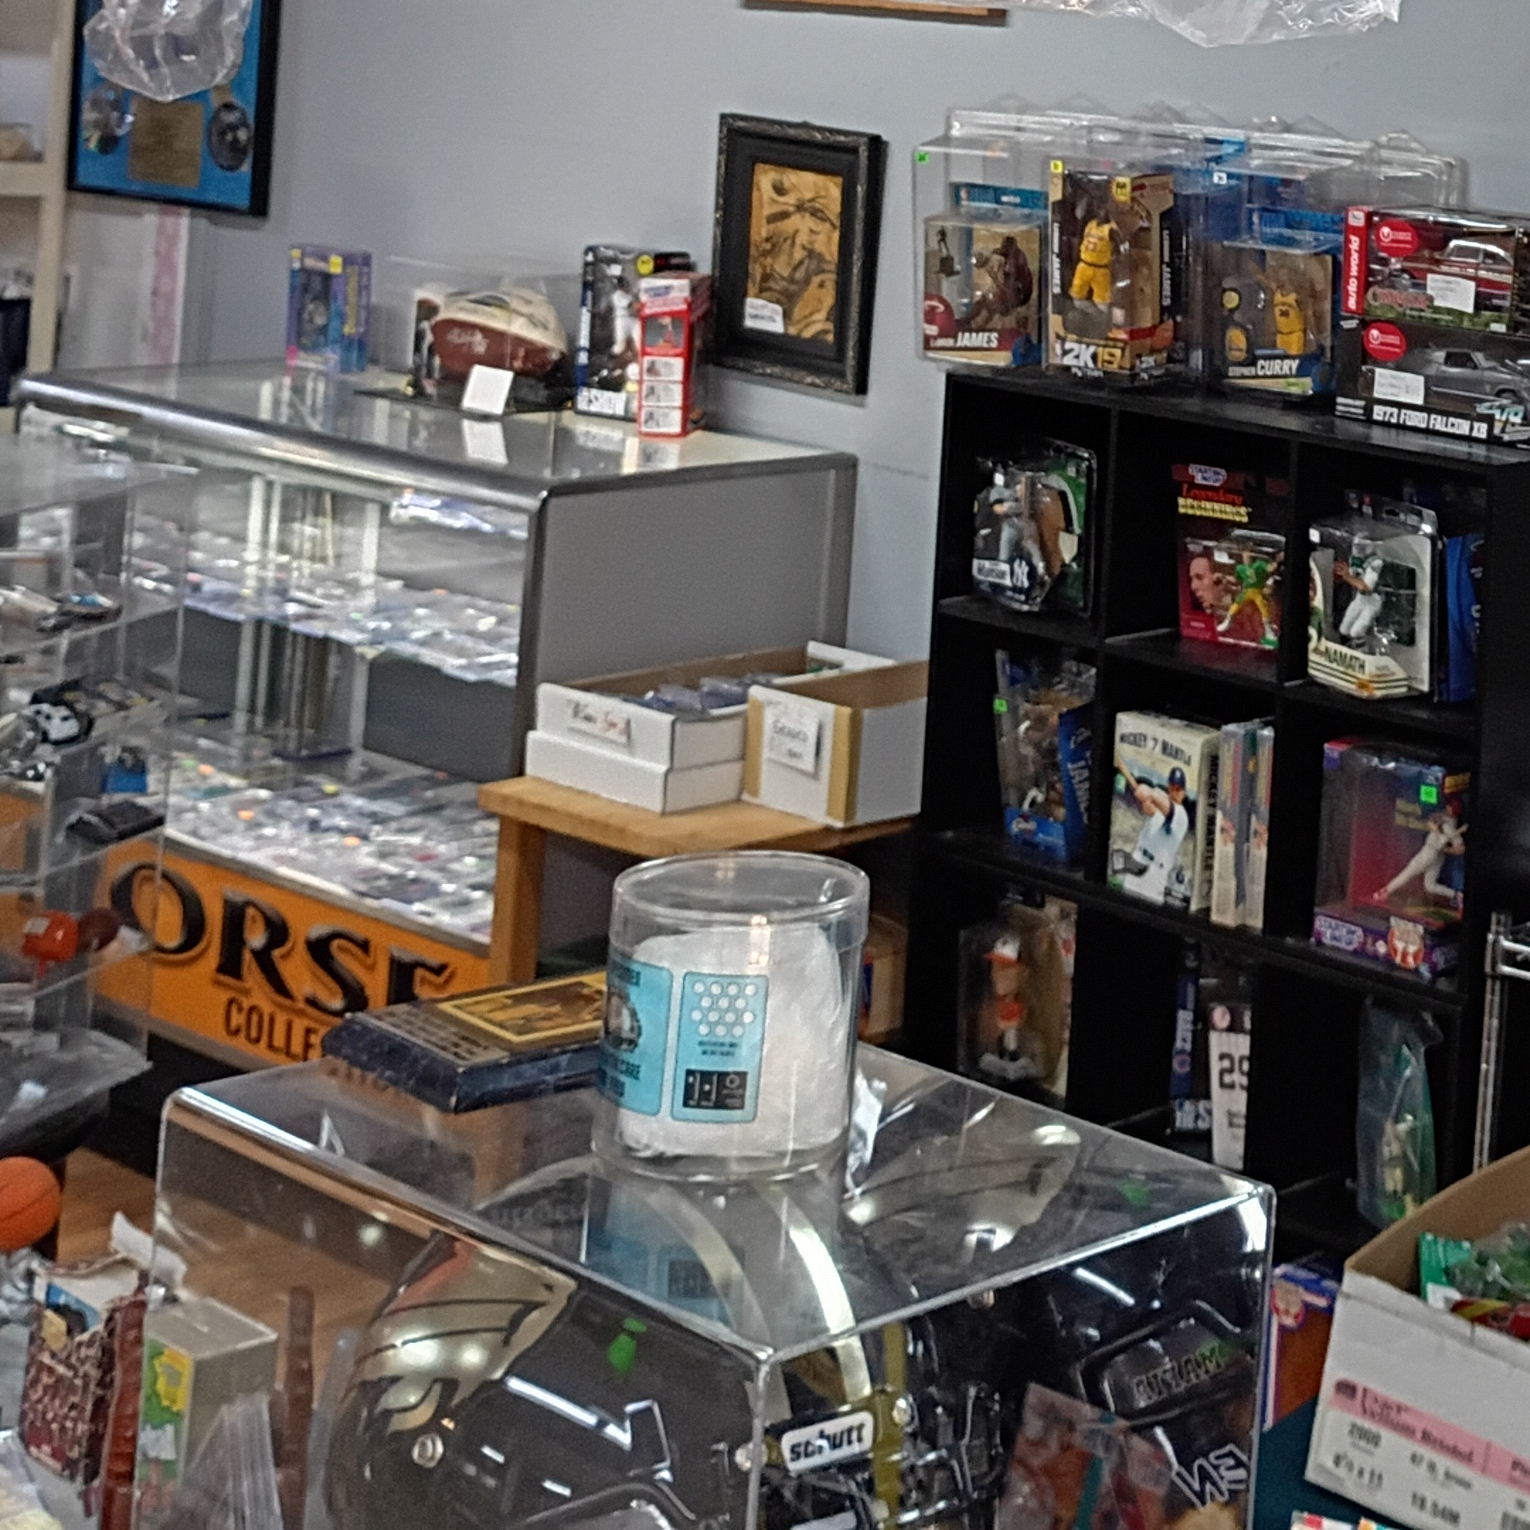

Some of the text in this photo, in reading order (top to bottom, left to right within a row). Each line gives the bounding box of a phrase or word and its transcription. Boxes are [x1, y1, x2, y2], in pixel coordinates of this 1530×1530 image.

[1347, 234, 1361, 311] auto world
[955, 331, 999, 349] JAMES
[1256, 359, 1300, 376] CURRY
[1372, 404, 1399, 423] 1973
[1400, 408, 1428, 428] FORD
[1429, 413, 1471, 436] FALCON
[1325, 645, 1366, 677] NAMATH
[1118, 732, 1148, 748] MICKEY
[789, 1422, 866, 1463] schutt
